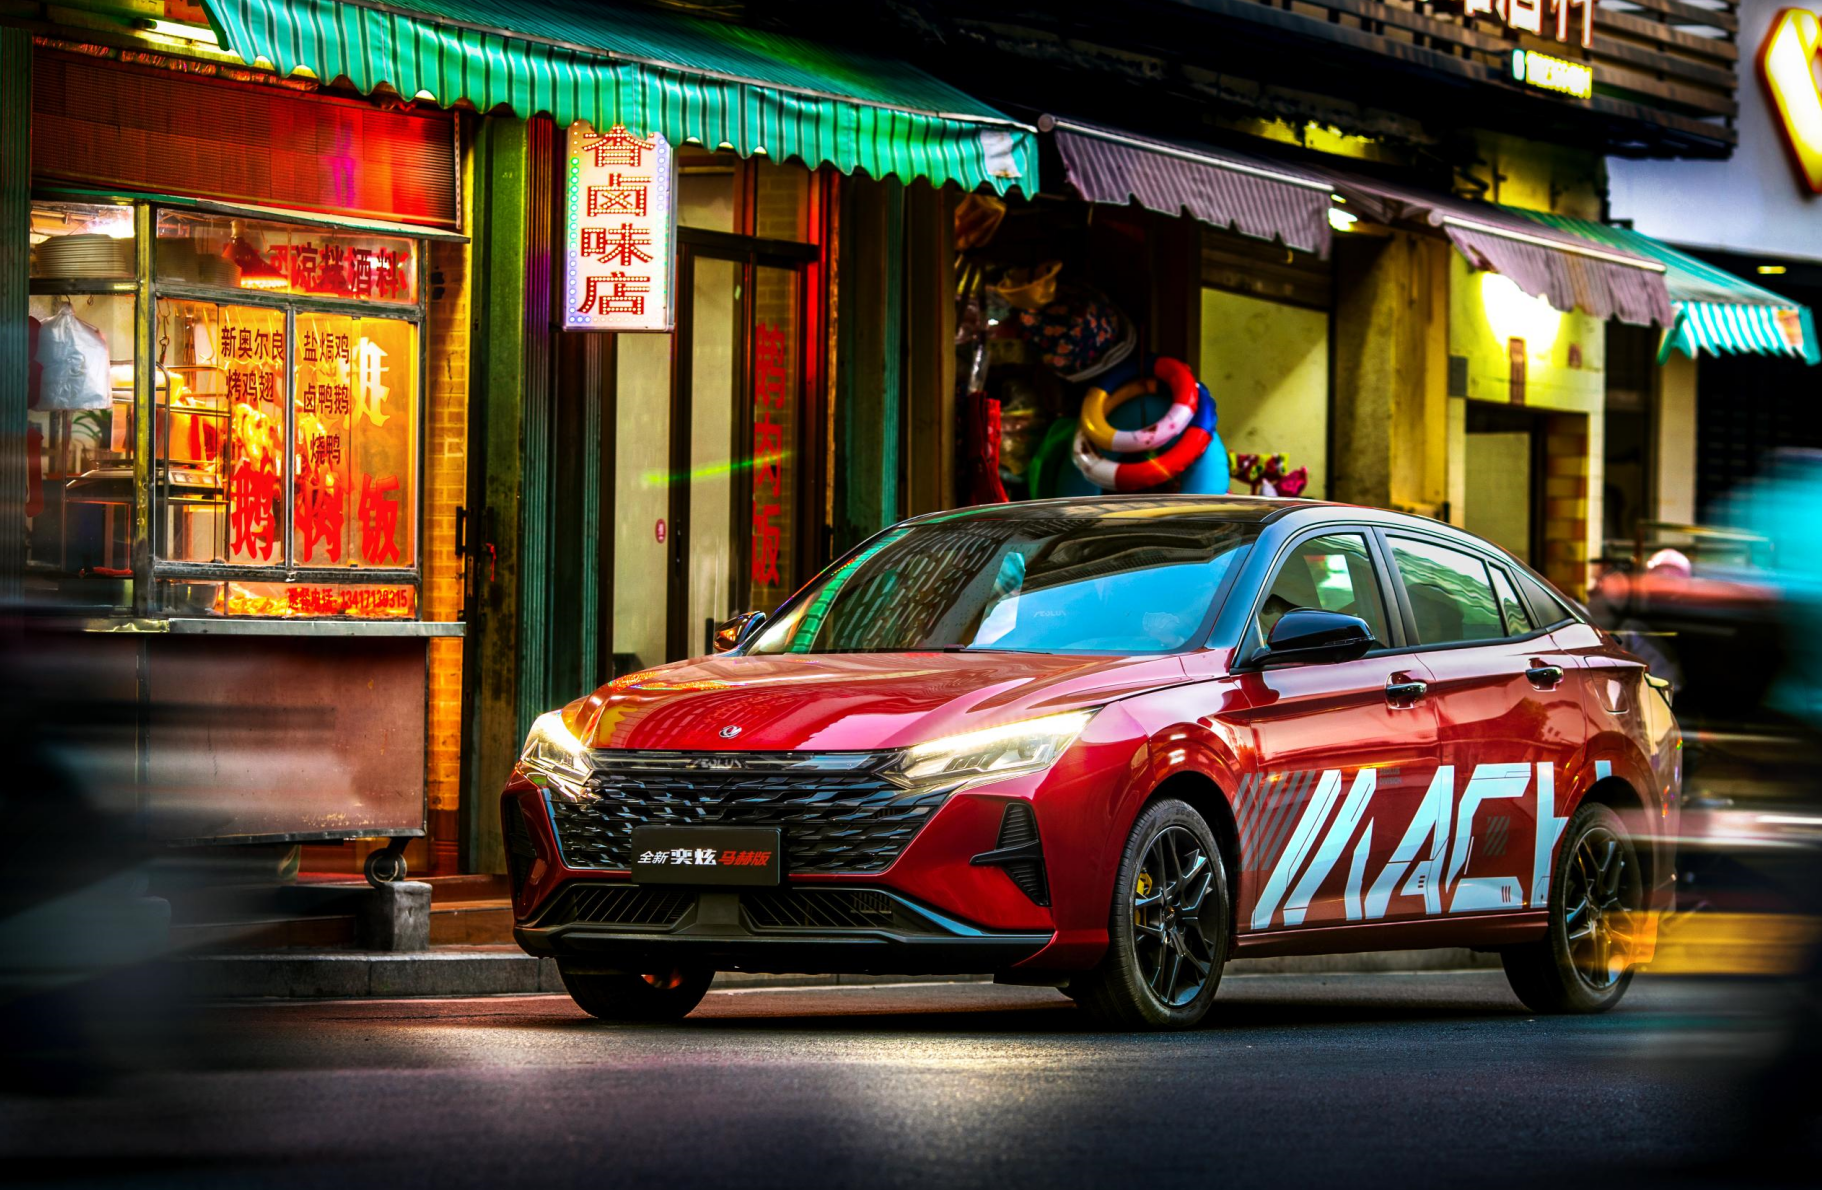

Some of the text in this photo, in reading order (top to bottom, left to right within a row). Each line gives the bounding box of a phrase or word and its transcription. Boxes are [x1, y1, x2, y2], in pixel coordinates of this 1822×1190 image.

[221, 326, 284, 361] 新奥尔良
[303, 331, 350, 364] 盐焗鸡
[226, 369, 274, 402] 烤鸡翅
[303, 383, 349, 415] 卤鸭鹅
[310, 433, 341, 465] 烧鸭
[229, 456, 401, 565] 鹅肉饭
